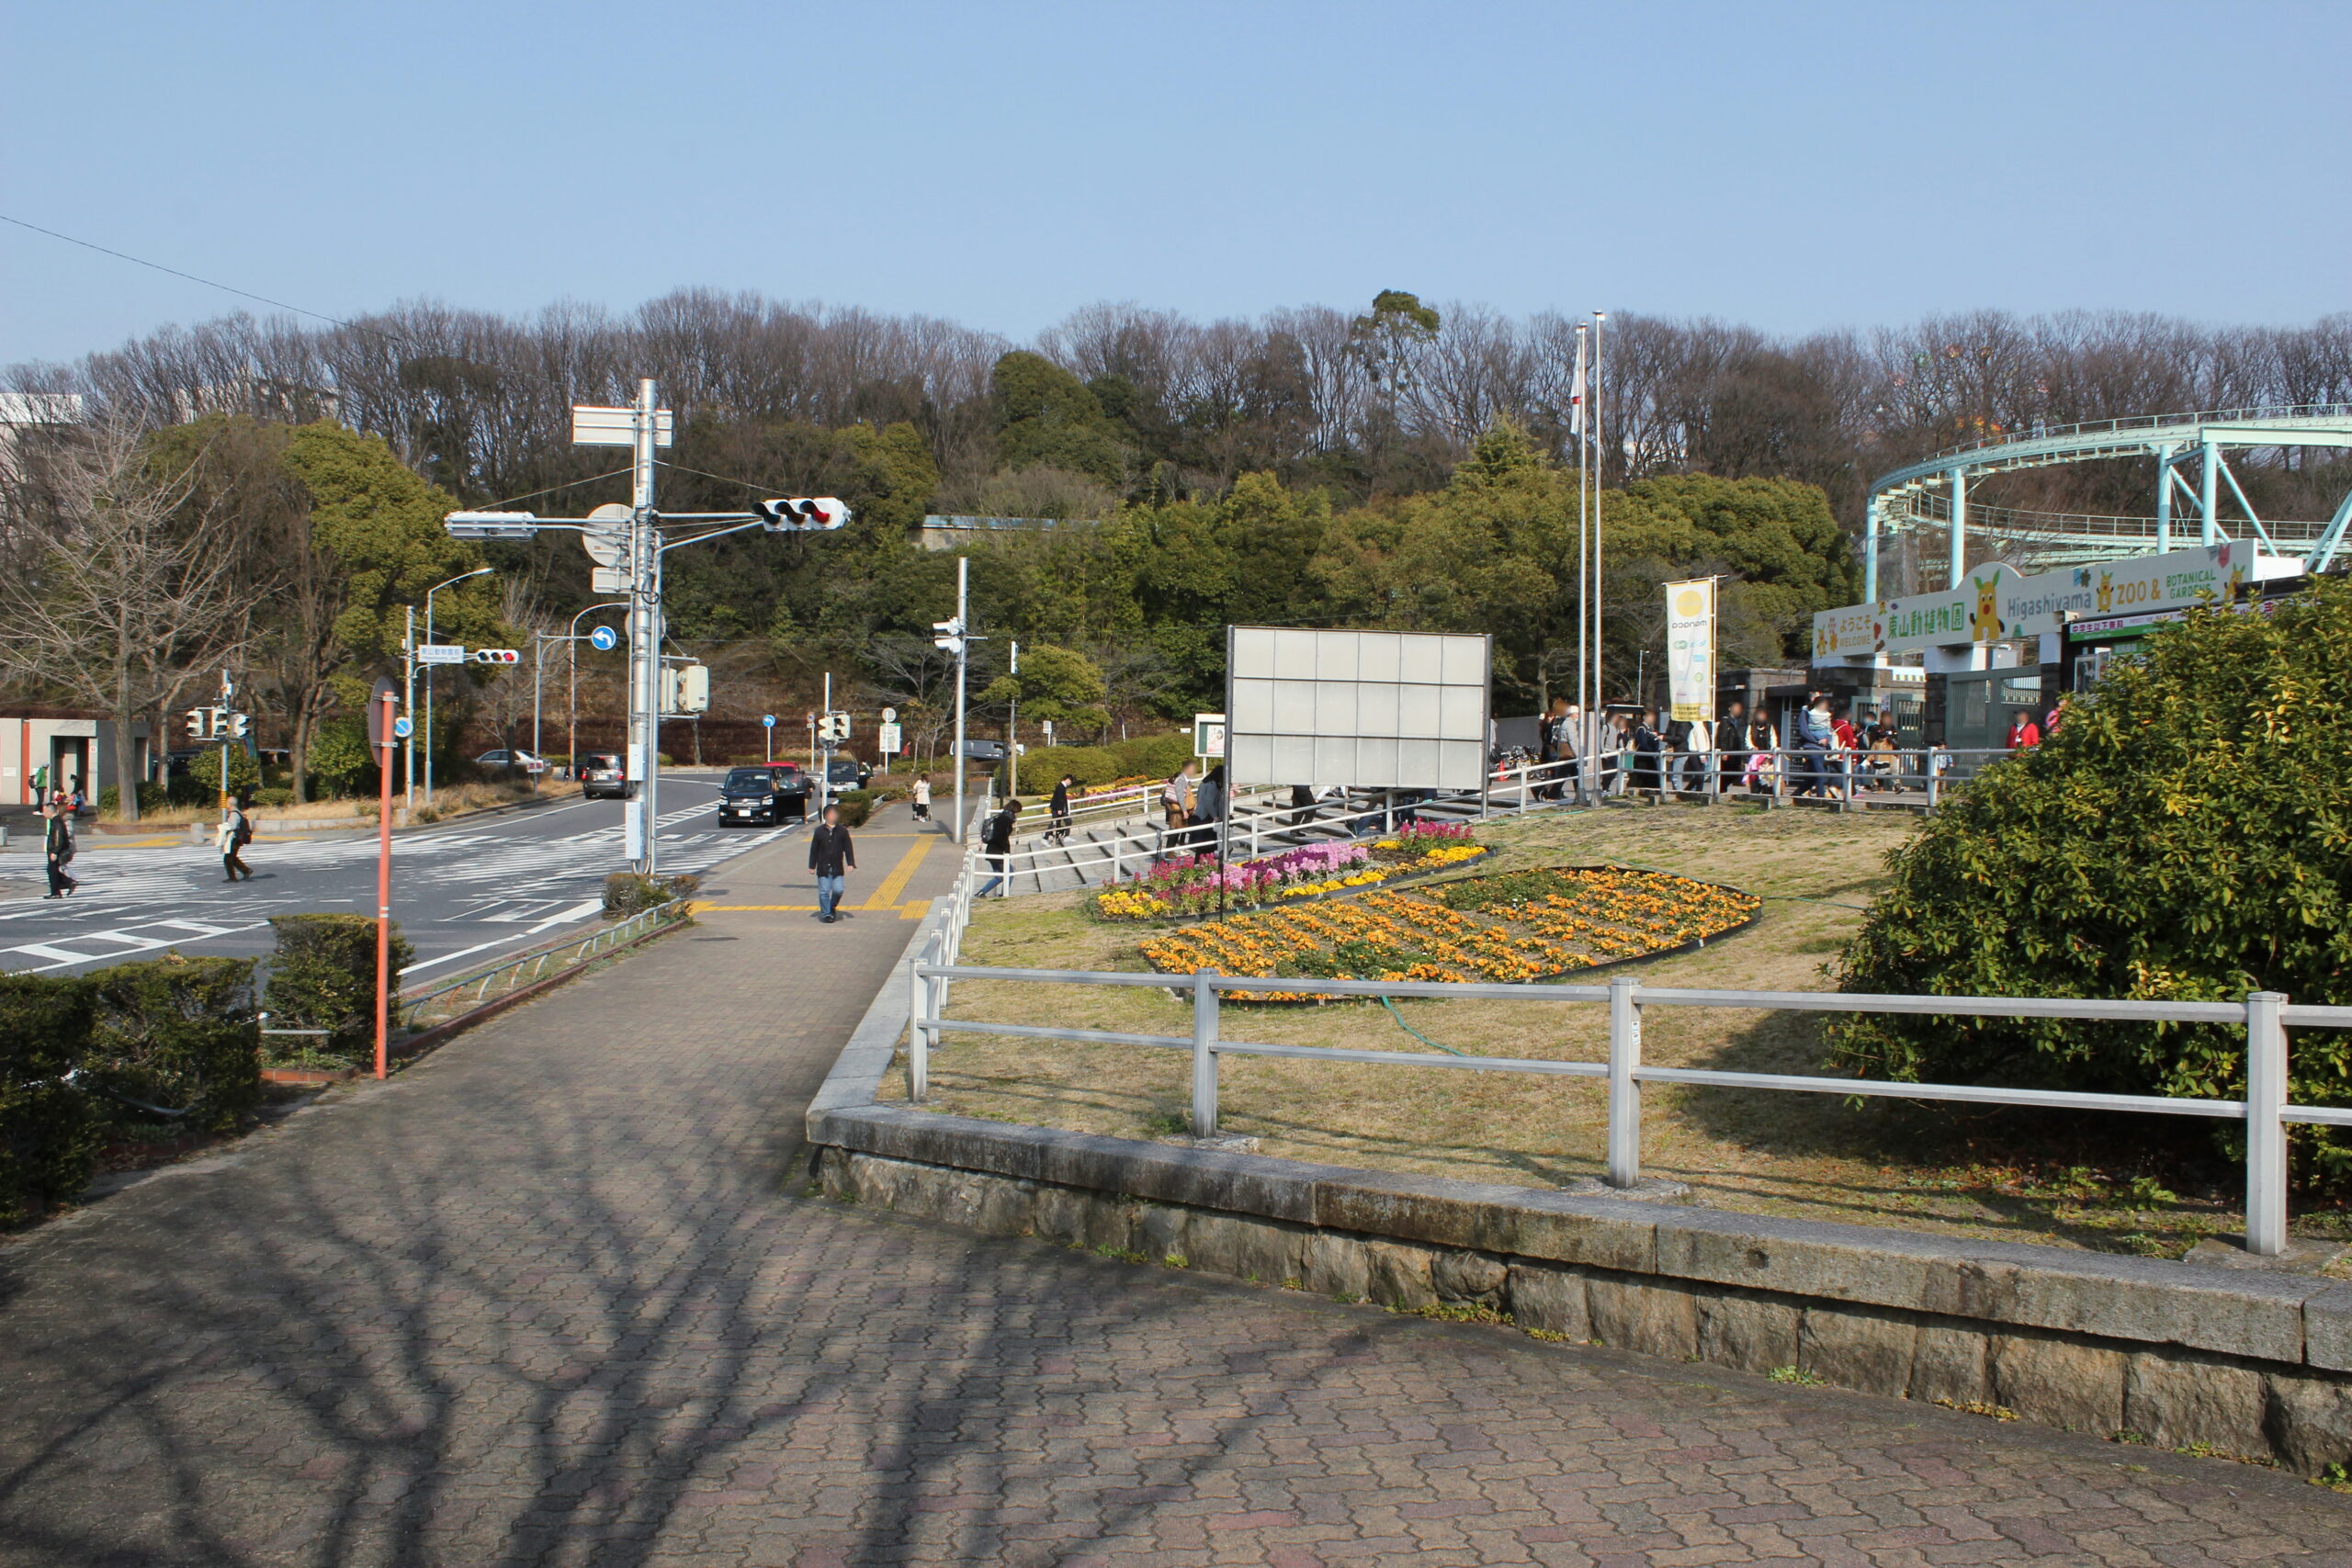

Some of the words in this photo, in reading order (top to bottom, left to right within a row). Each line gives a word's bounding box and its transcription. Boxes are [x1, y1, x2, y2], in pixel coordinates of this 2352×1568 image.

[2166, 569, 2217, 587] BOTANICAL
[2007, 592, 2092, 620] Higashiyama
[2117, 581, 2147, 605] ZOO
[2151, 579, 2162, 601] &
[1839, 615, 1872, 634] ようこそ
[1887, 602, 1965, 639] 東山動植物園
[1839, 635, 1871, 648] WELCOME
